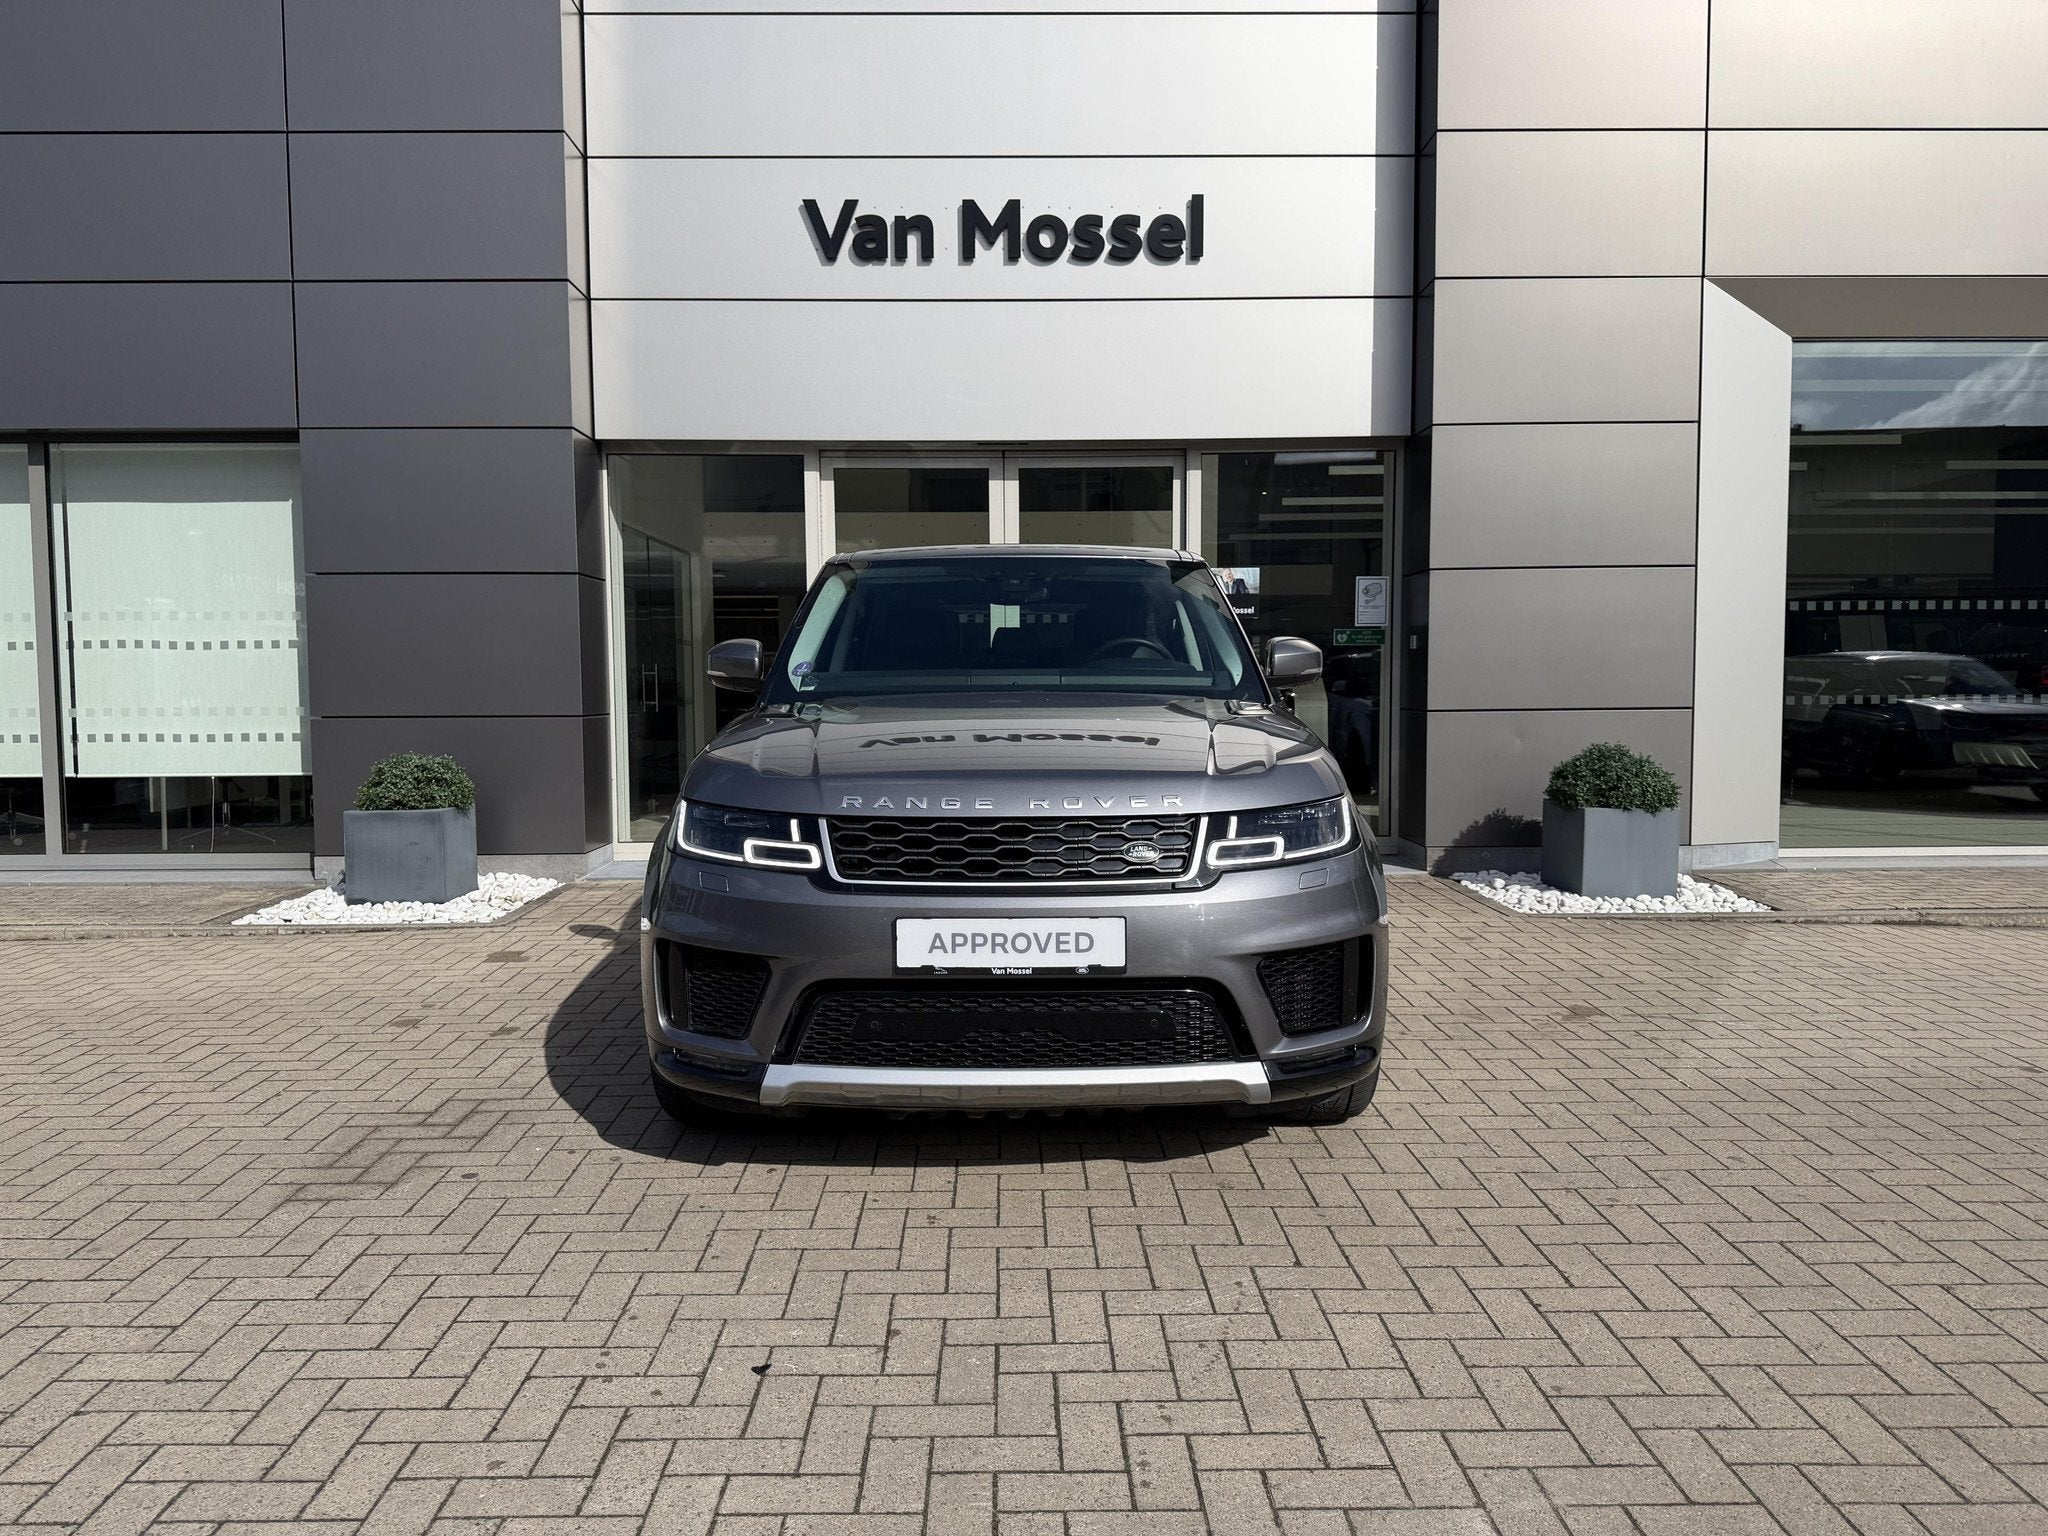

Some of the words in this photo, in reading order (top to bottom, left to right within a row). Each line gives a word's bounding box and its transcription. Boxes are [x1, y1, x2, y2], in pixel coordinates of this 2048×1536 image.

[802, 198, 934, 261] Van
[961, 194, 1205, 261] Mossel
[1233, 606, 1255, 614] ossel
[840, 796, 994, 810] RANGE
[1029, 795, 1184, 809] ROVER
[928, 932, 1095, 954] APPROVED
[991, 967, 1005, 975] Van
[1007, 967, 1033, 975] Mossel
